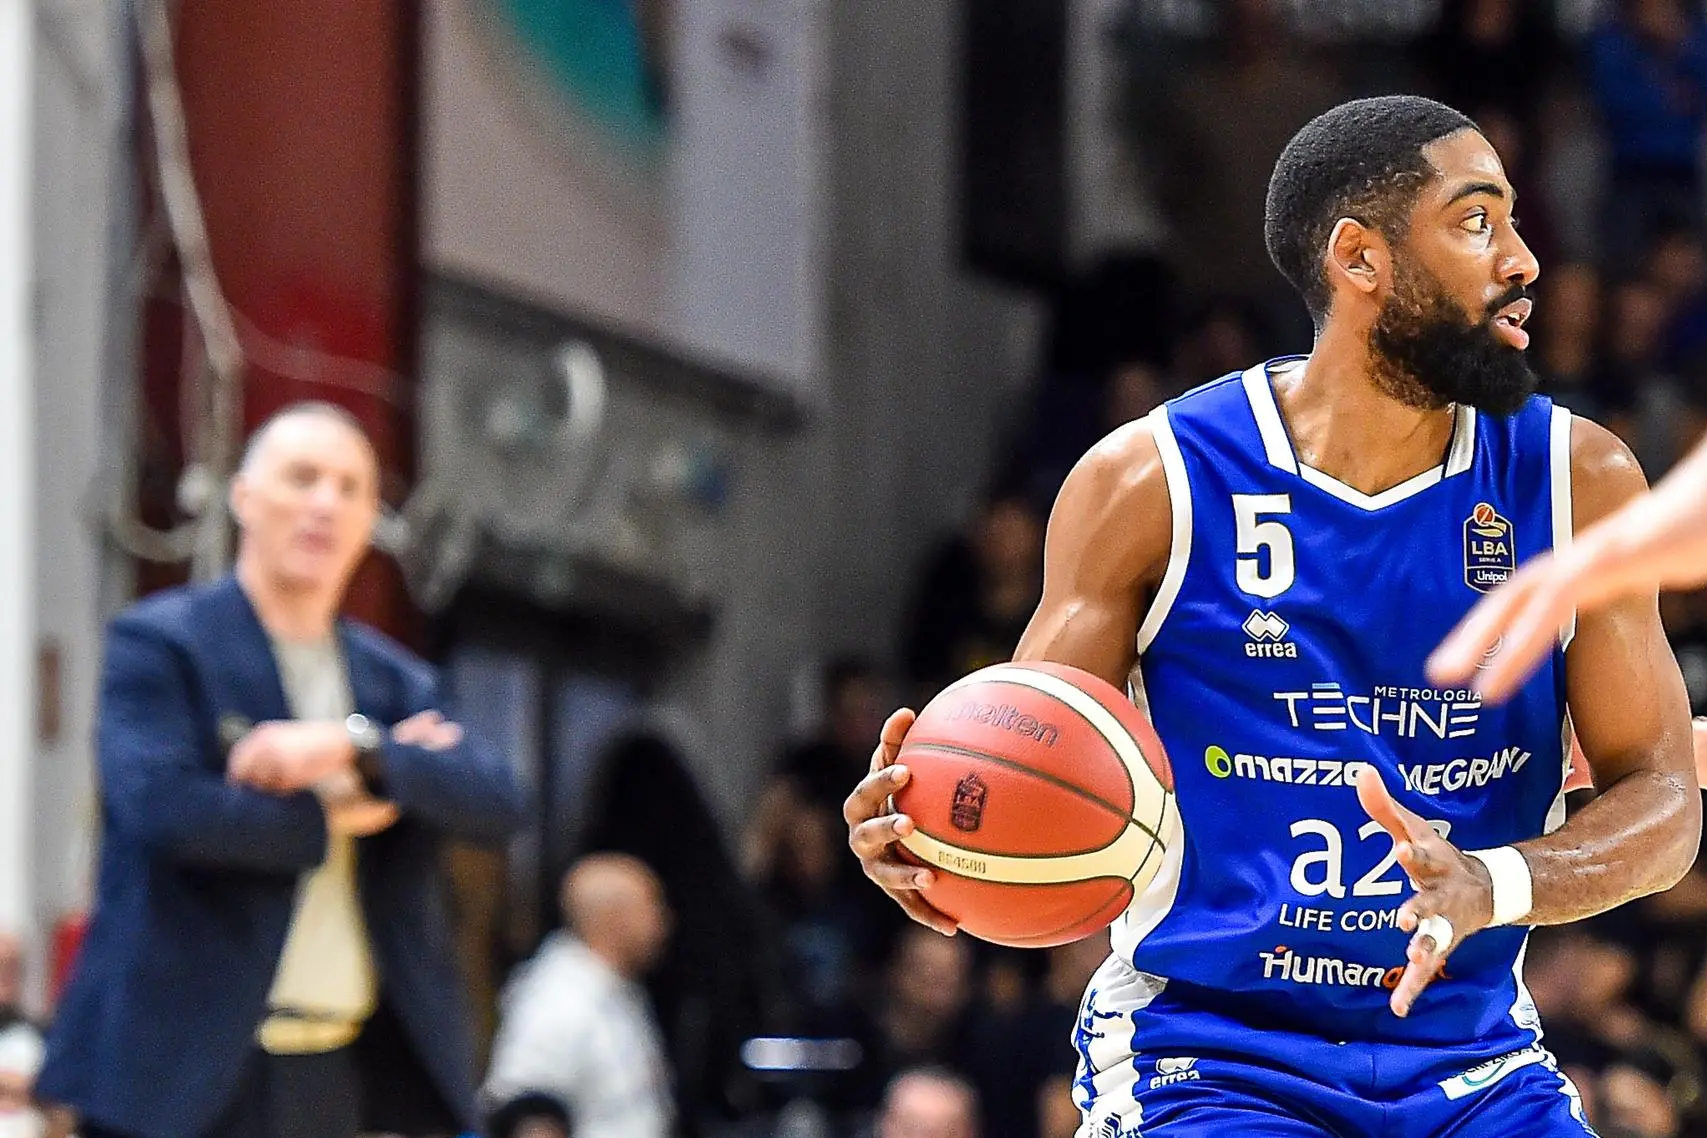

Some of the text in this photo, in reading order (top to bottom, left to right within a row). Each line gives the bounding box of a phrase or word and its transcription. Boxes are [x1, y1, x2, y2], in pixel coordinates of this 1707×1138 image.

[1232, 493, 1295, 598] 5
[1471, 541, 1509, 555] LBA
[1477, 570, 1508, 584] Unipol
[1374, 685, 1483, 702] METROLOGIA
[1290, 818, 1451, 899] a2
[1279, 903, 1403, 932] LIFE COM
